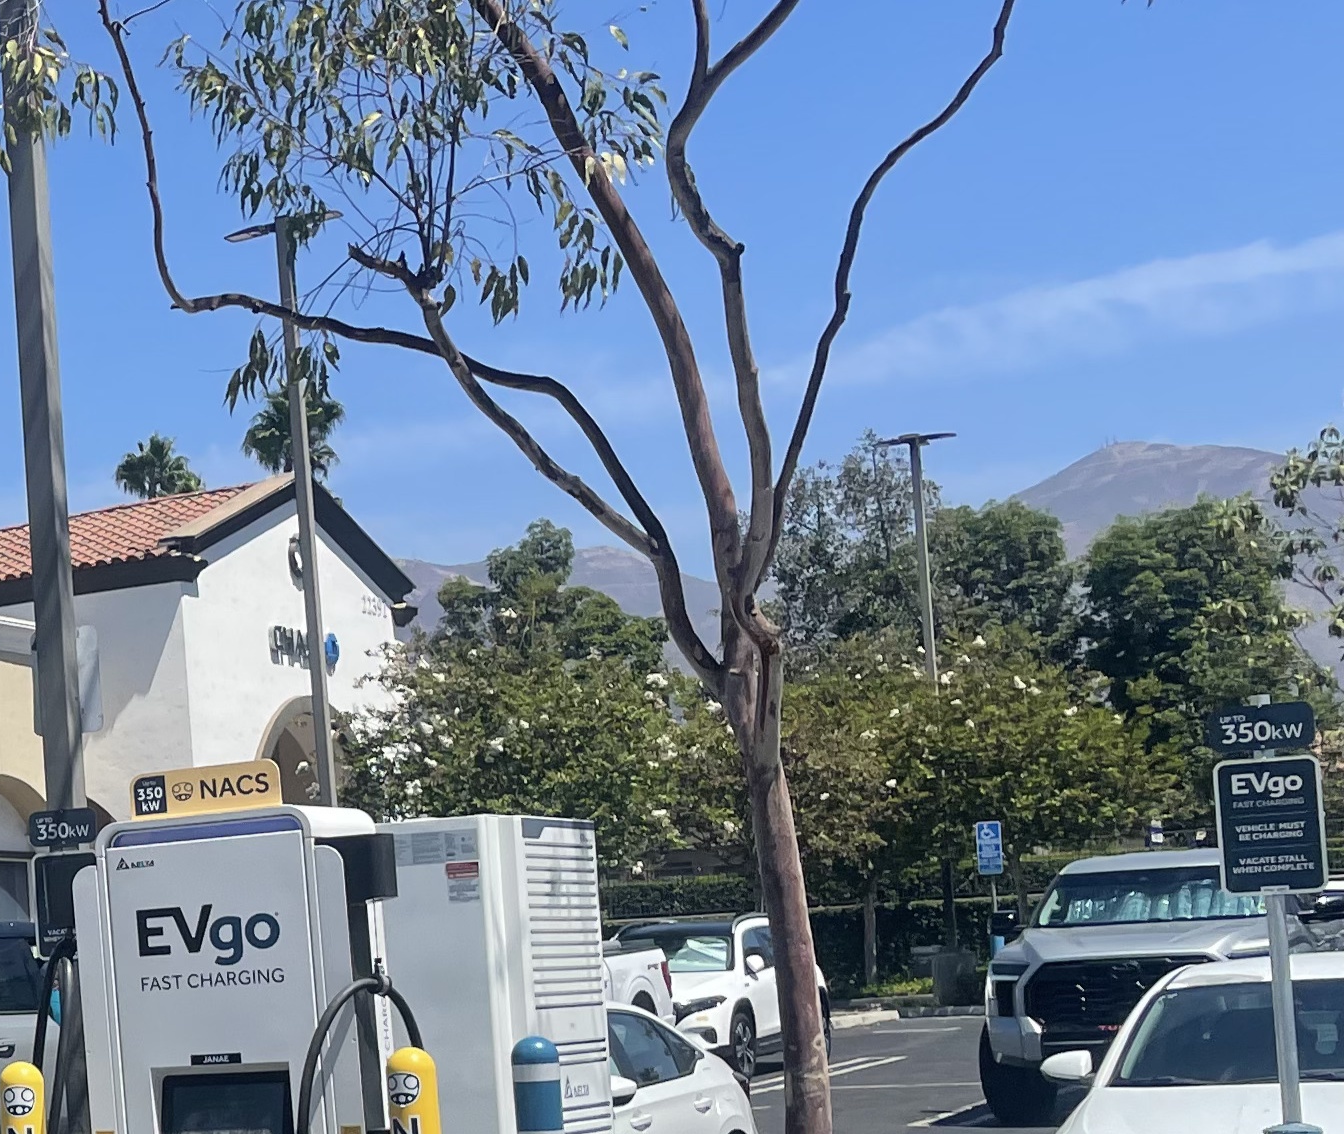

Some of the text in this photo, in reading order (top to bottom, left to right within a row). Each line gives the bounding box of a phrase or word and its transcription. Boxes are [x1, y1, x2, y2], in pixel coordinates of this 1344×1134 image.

[1219, 715, 1246, 724] UP TO
[1221, 721, 1303, 745] 350kW
[200, 773, 270, 799] NACS
[1230, 771, 1303, 798] EVgo
[136, 787, 163, 799] 350
[141, 800, 160, 812] kW
[1232, 797, 1305, 808] FAST CHARGING
[37, 822, 89, 841] 350kW
[1235, 821, 1306, 833] VEHICLE MUST
[1238, 830, 1303, 841] BE CHARGING
[1238, 854, 1307, 865] VACATE STALL
[1232, 862, 1315, 874] WHEN COMPLETE
[136, 904, 280, 965] EVgo
[141, 967, 285, 992] FAST CHARGING
[203, 1055, 230, 1063] JANAE
